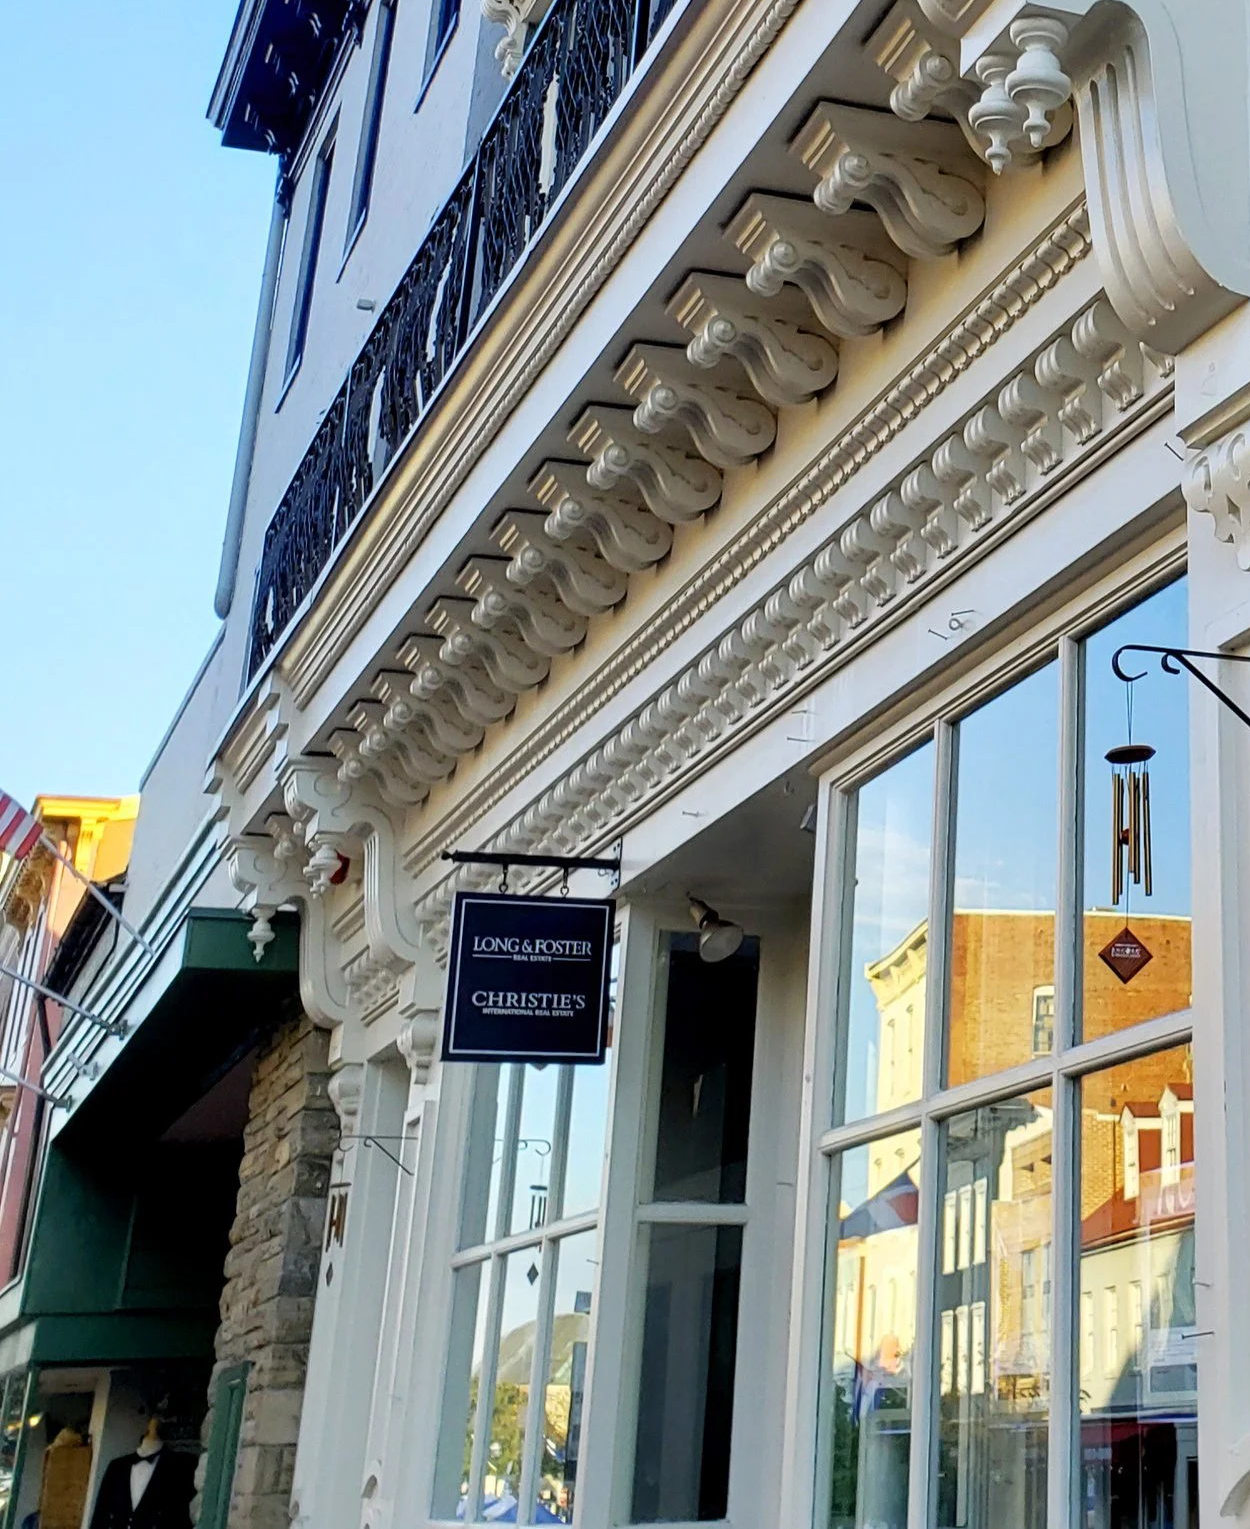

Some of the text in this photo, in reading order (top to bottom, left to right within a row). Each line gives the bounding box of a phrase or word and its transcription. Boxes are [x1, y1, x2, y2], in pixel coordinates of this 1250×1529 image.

[473, 936, 591, 955] LONG & FOSTER
[530, 954, 551, 962] ESTATE
[472, 991, 585, 1009] CHRISTIE'S
[482, 1008, 533, 1016] INTERNATIONAL
